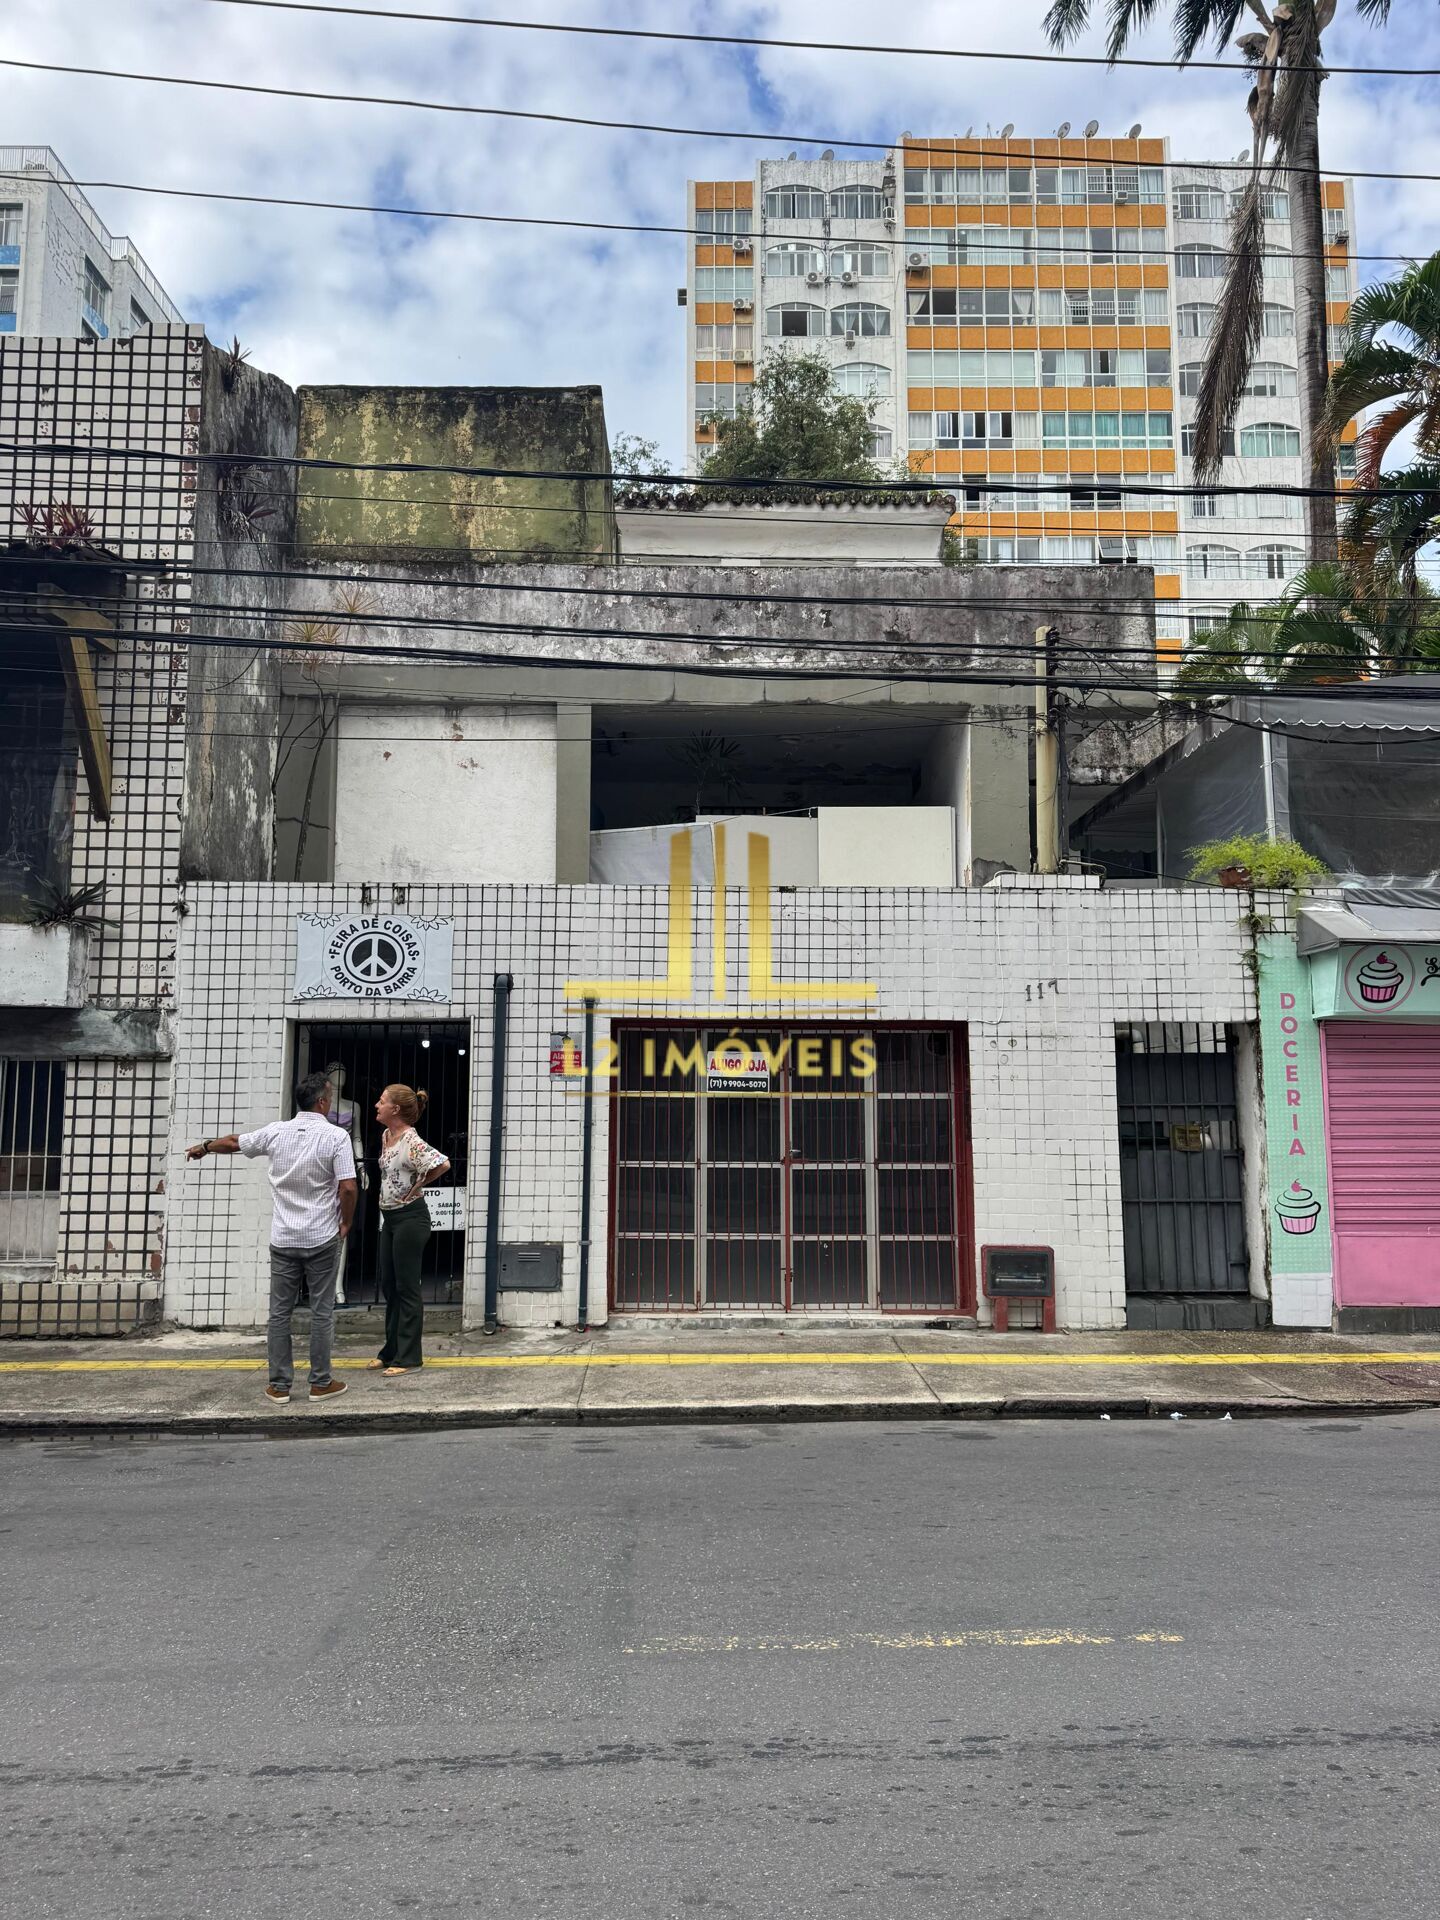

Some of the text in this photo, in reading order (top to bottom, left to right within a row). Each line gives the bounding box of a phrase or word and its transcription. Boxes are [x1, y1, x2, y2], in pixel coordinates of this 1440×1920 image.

[329, 918, 420, 958] FEIRA DE COISAS
[330, 965, 418, 997] PORTO DA BARRA
[709, 1078, 722, 1089] (71)
[728, 1080, 767, 1088] 9904-5070
[1279, 992, 1306, 1156] DOCERIA
